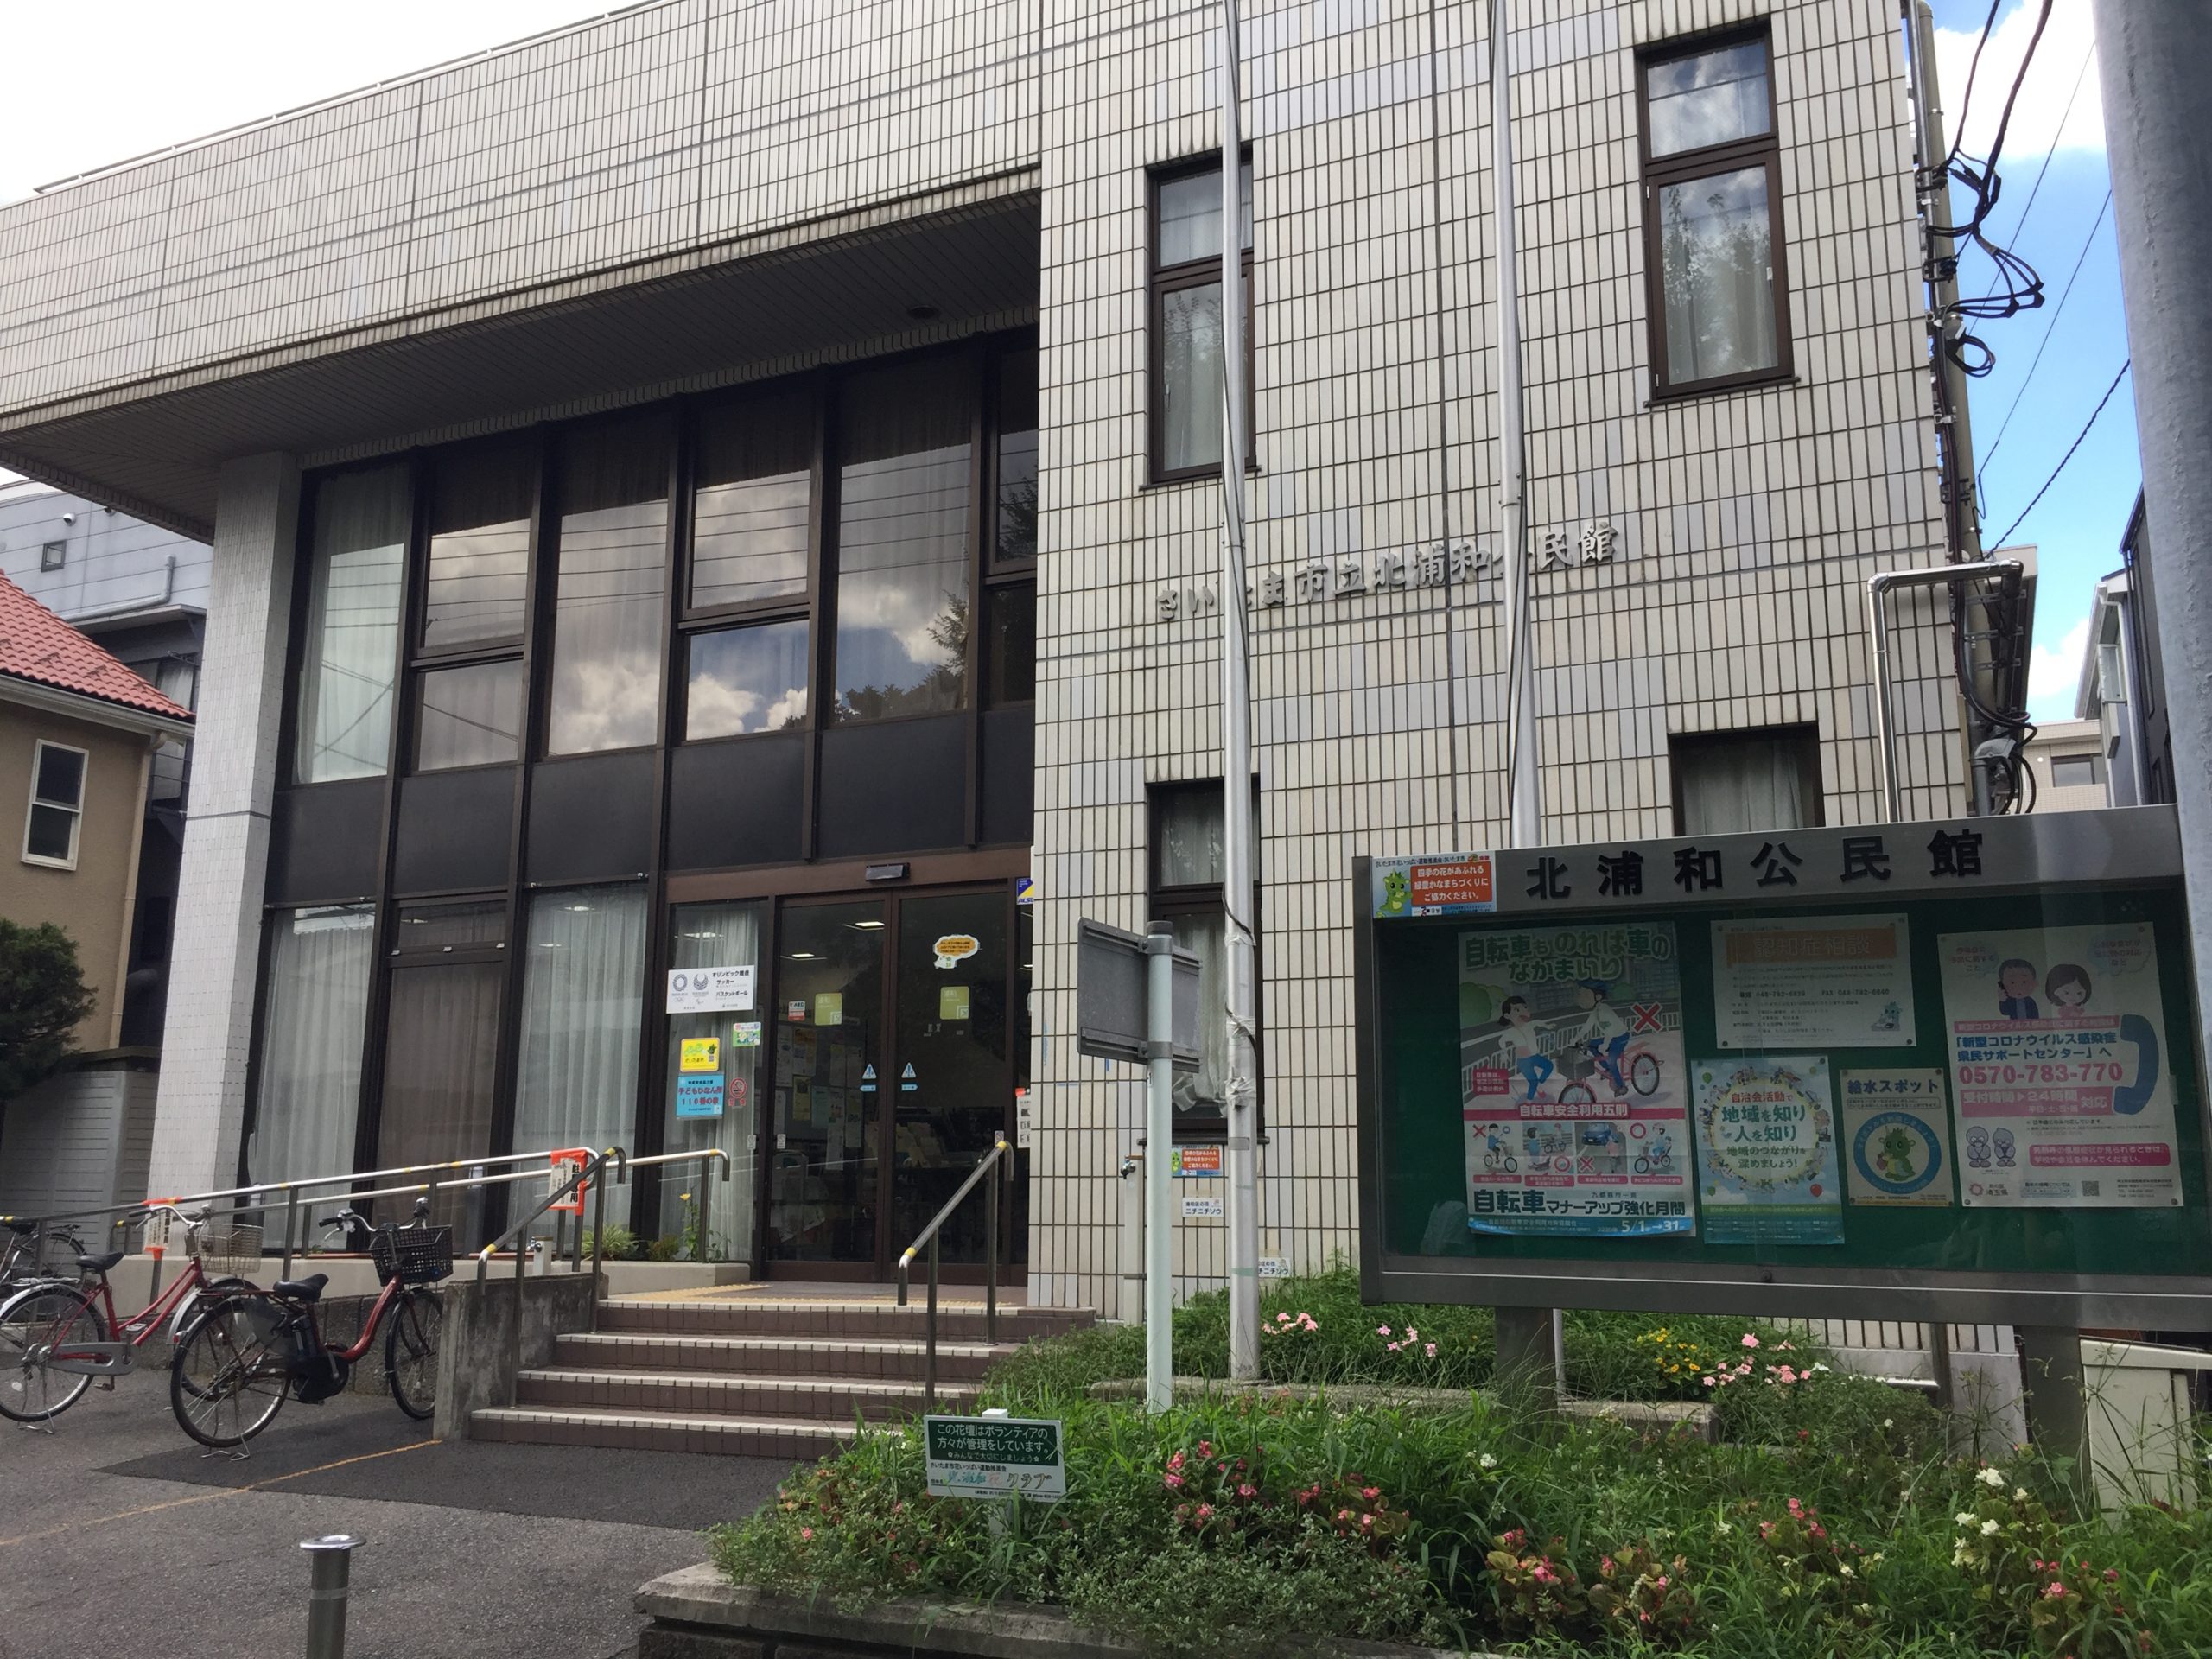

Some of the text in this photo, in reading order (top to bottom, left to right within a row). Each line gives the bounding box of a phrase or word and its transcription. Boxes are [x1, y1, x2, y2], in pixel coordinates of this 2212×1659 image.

[1156, 521, 1618, 621] さいま市立北浦和民館
[1417, 865, 1484, 878] 四季の花があふれる
[1526, 829, 1984, 900] 北浦和公民館
[1414, 878, 1490, 890] 緑豊かなまちづくりに
[1424, 891, 1479, 902] ご協力ください。
[1465, 927, 1671, 969] 自転車ものれば車の
[1754, 935, 1871, 958] 認知症相談
[1508, 955, 1623, 983] なかまいり
[1957, 1032, 2117, 1048] 「新型コロナウイルス感染症
[1957, 1046, 2113, 1062] 県民サポートセンター」へ
[1958, 1062, 2123, 1084] 0570-783-770
[1847, 1078, 1939, 1095] 給水スポット
[1732, 1090, 1794, 1103] 自治会活動で
[1963, 1089, 2108, 1109] 受付時間 24時間 対応
[1519, 1103, 1629, 1117] 自転車安全利用五則
[1721, 1104, 1806, 1123] 地域を知り
[1734, 1124, 1797, 1143] 人を知り
[1726, 1146, 1807, 1157] 地域のつながりを
[570, 1164, 581, 1203] 駐用
[1473, 1189, 1686, 1216] 自転車マナーアップ強化月間
[937, 1424, 1048, 1440] この花壇はボランティアの
[937, 1437, 1049, 1454] 方々が管理をしています。
[953, 1452, 1035, 1463] みんなで大切にしましょう
